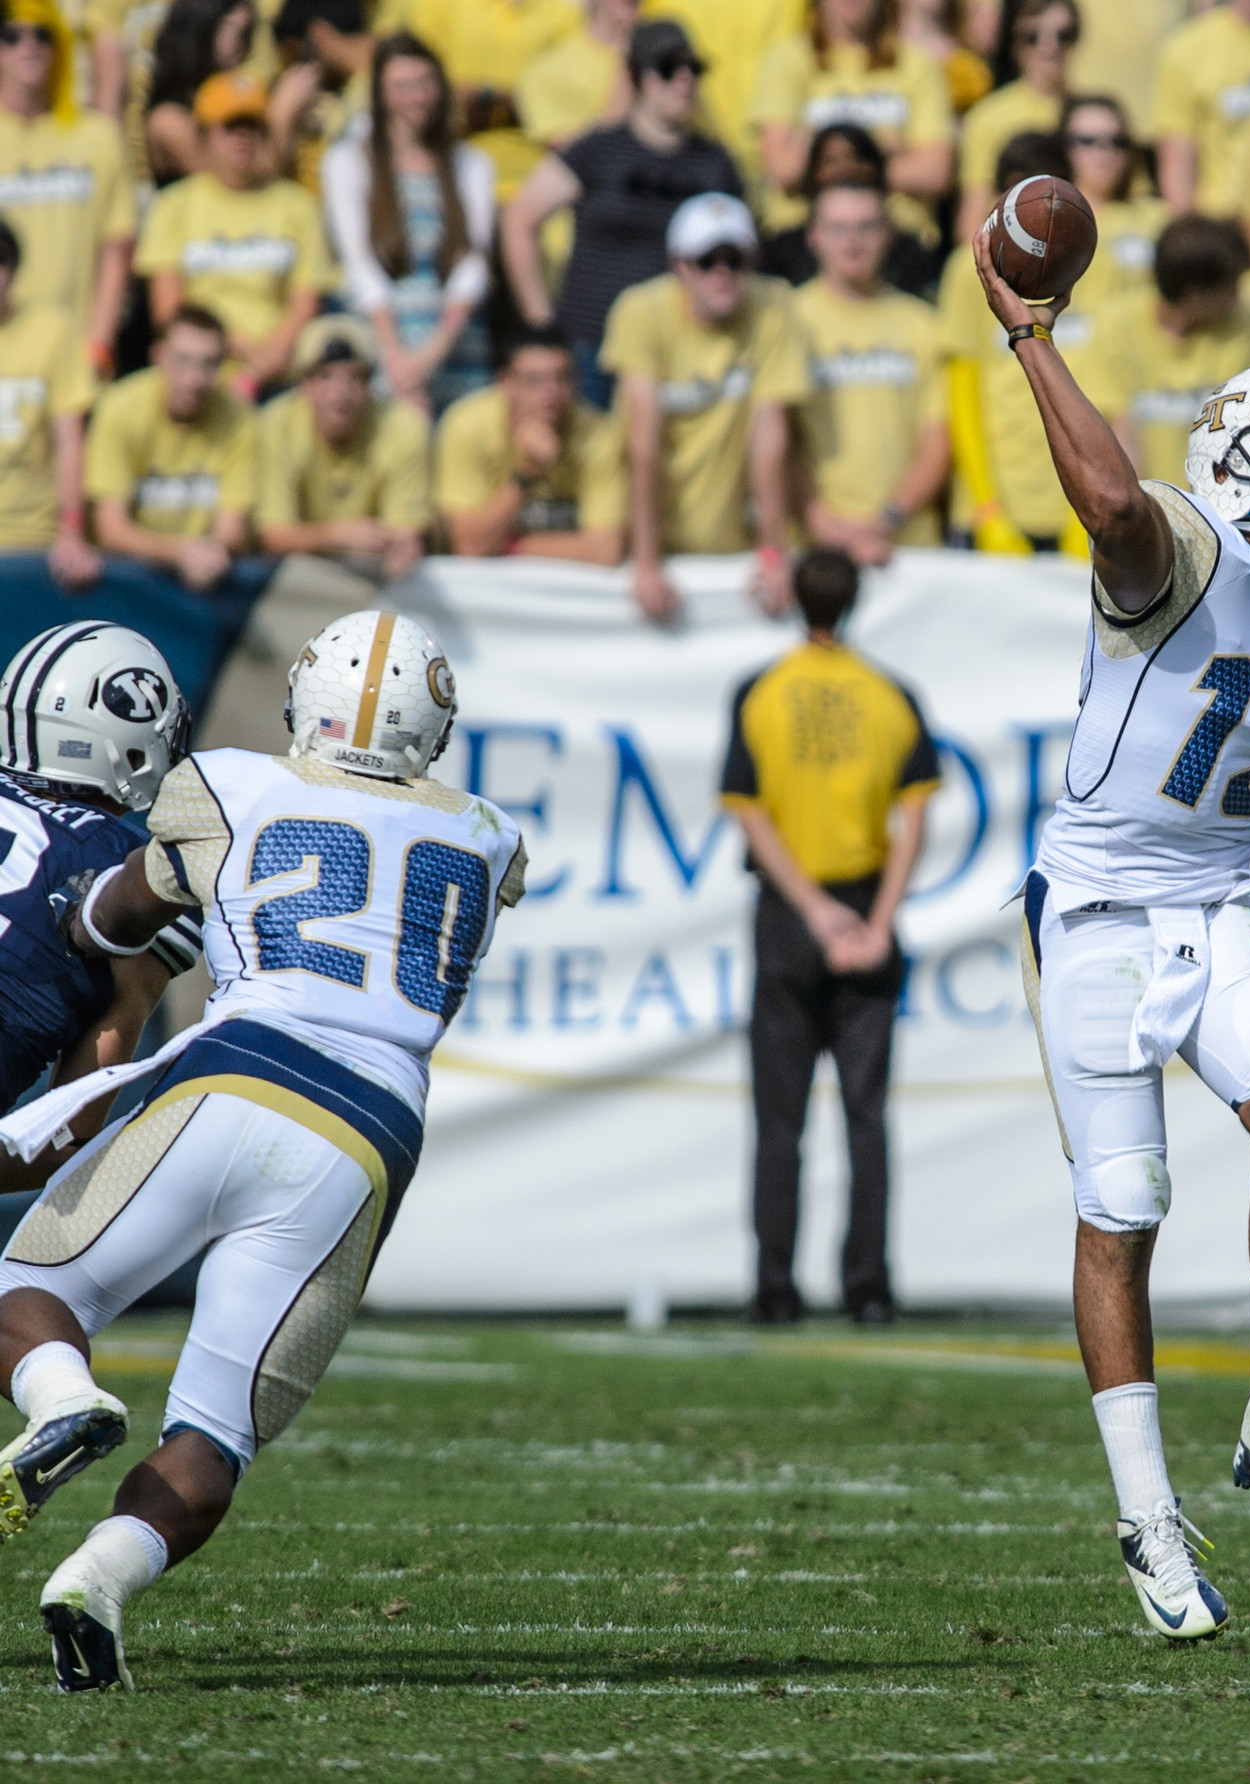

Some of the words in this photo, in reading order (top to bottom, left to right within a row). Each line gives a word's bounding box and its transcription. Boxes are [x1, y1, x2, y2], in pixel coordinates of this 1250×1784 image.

[54, 696, 66, 712] 2
[386, 710, 402, 726] 20
[335, 749, 384, 769] JACKETS
[244, 814, 490, 1028] 20
